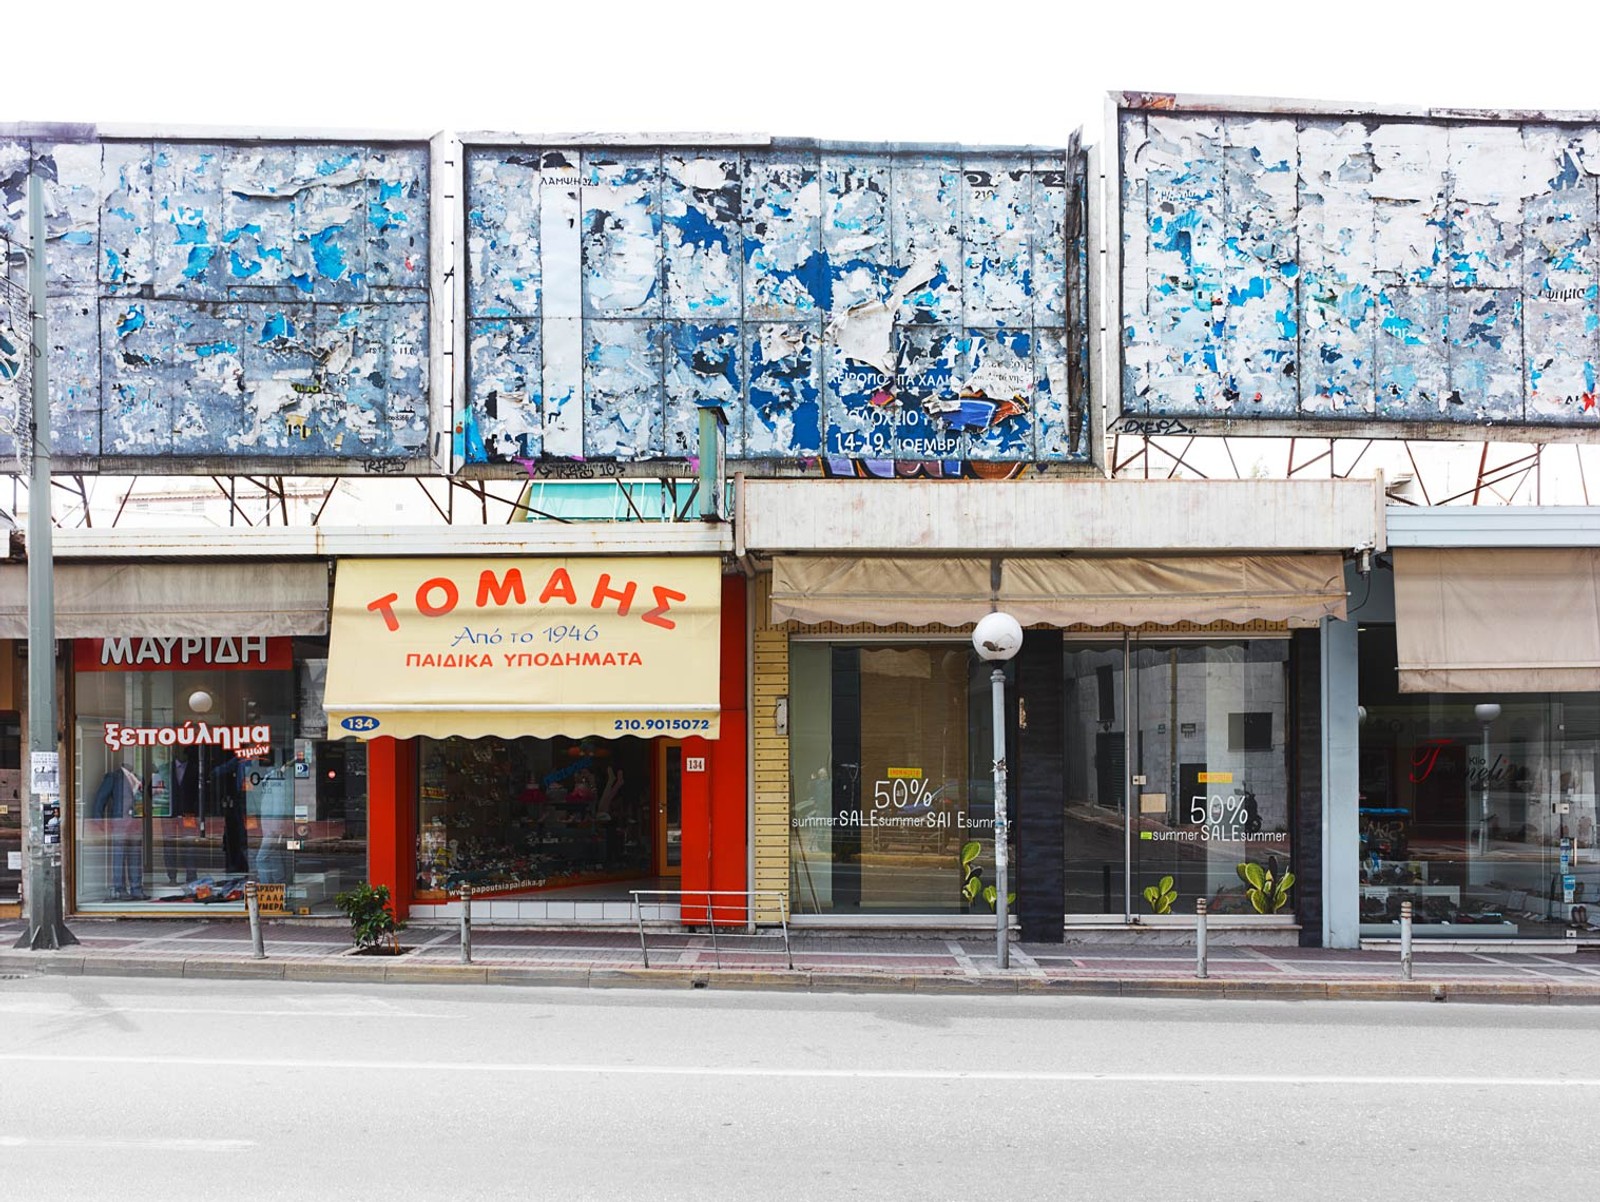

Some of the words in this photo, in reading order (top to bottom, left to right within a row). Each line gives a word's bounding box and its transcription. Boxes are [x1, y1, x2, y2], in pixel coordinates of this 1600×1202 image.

[367, 567, 686, 632] ΤΟΜΑΗΣ
[451, 626, 503, 647] Από
[510, 630, 534, 644] το
[542, 624, 600, 643] 1946
[101, 636, 268, 664] ΜΑΥΡΙΔΗ
[405, 653, 494, 668] ΠΑΙΔΙΚΑ
[503, 652, 643, 667] ΥΠΟΔΗΜΑΤΑ
[346, 718, 375, 730] 134
[613, 719, 710, 731] 210.9015072
[104, 721, 271, 752] ξεπούλημα
[233, 744, 271, 759] τιμών
[688, 760, 703, 770] 134
[874, 778, 933, 809] 50%
[1190, 795, 1249, 825] 50%
[1200, 824, 1241, 841] SALE
